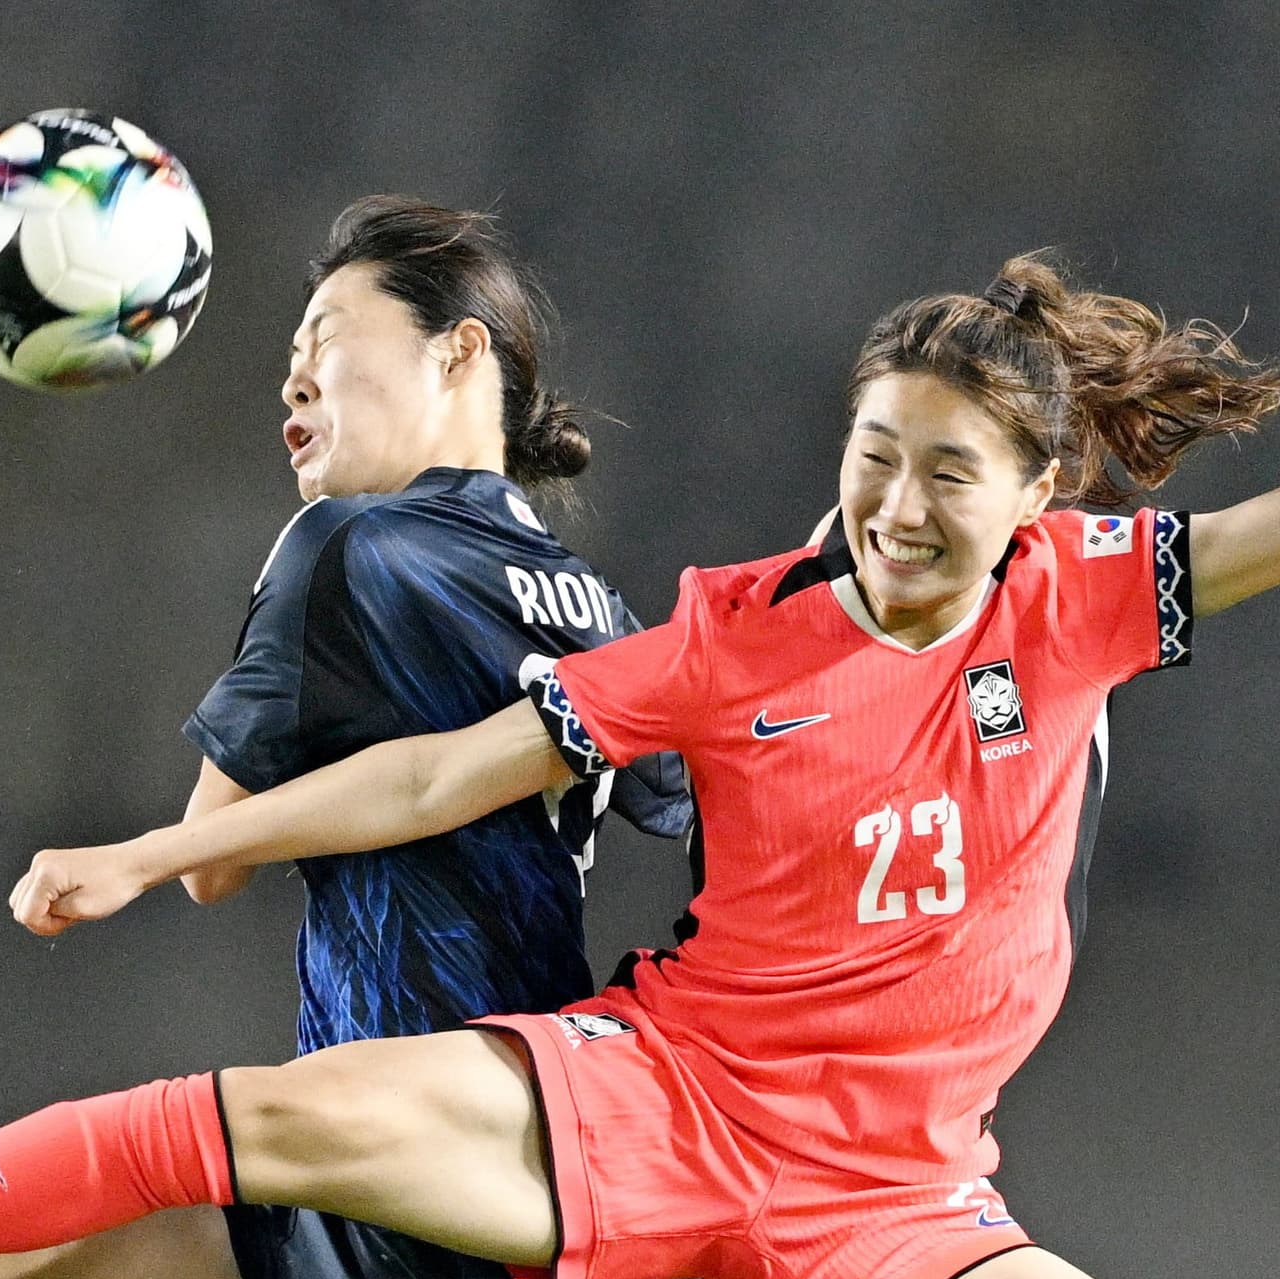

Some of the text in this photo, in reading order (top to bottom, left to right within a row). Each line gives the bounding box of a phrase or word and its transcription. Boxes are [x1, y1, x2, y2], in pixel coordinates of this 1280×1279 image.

[980, 739, 1033, 763] KOREA
[854, 790, 966, 924] 23
[544, 1012, 582, 1050] OREA
